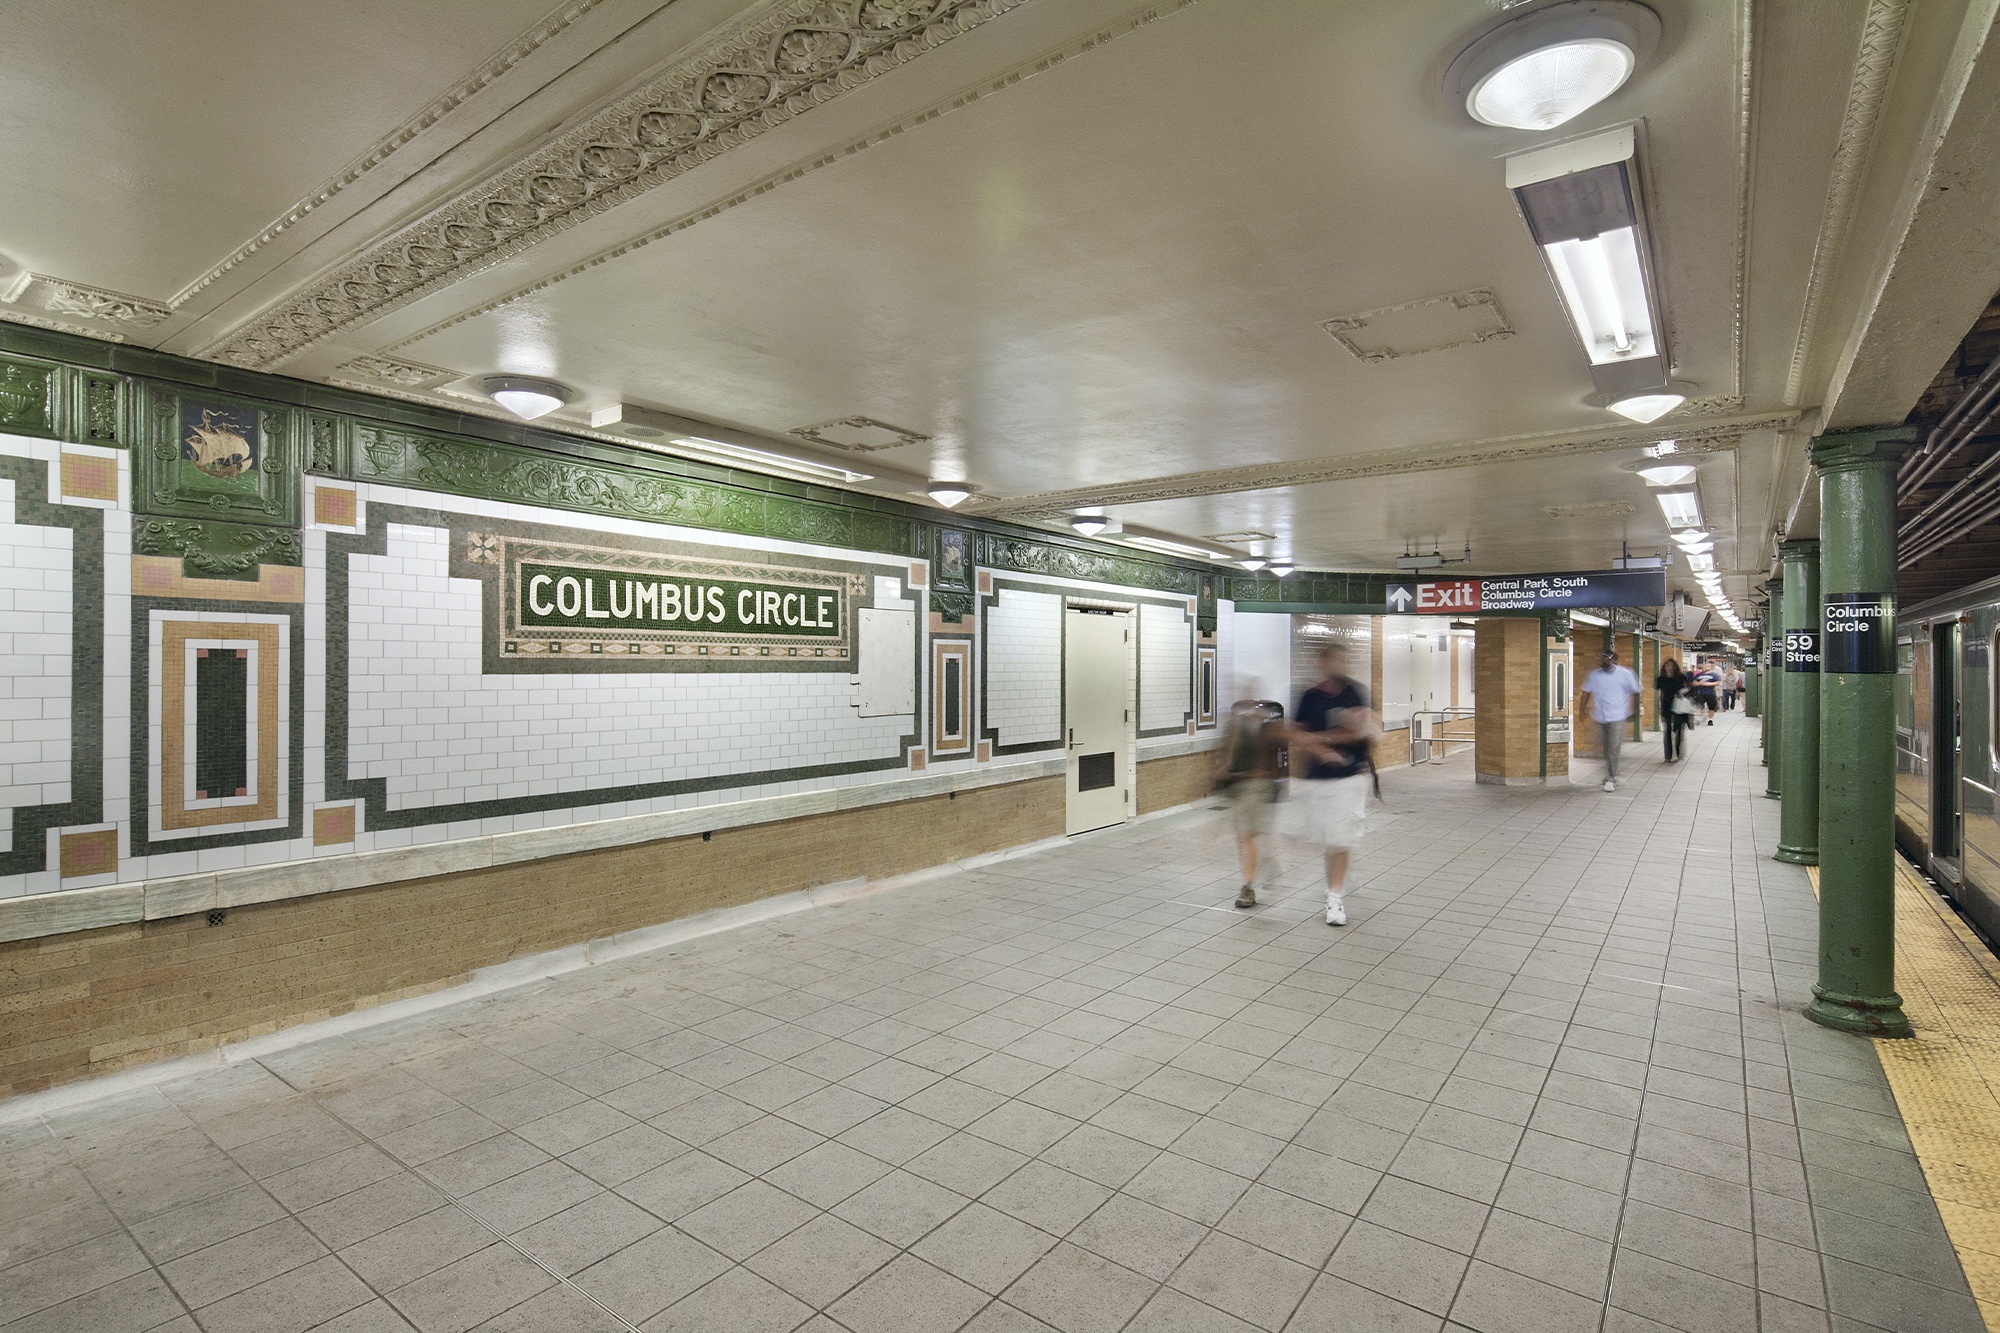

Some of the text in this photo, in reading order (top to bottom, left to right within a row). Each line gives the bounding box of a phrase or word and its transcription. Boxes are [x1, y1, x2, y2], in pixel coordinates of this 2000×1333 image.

[1481, 577, 1588, 591] Central Park South
[1417, 583, 1473, 607] Exit
[1481, 588, 1572, 599] Columbus Circle
[529, 574, 834, 628] COLUMBUS CIRCLE
[1481, 599, 1535, 610] Broadway
[1826, 606, 1896, 618] Columbus
[1826, 620, 1869, 632] Circle
[1786, 635, 1813, 651] 59
[1786, 651, 1820, 662] Stree
